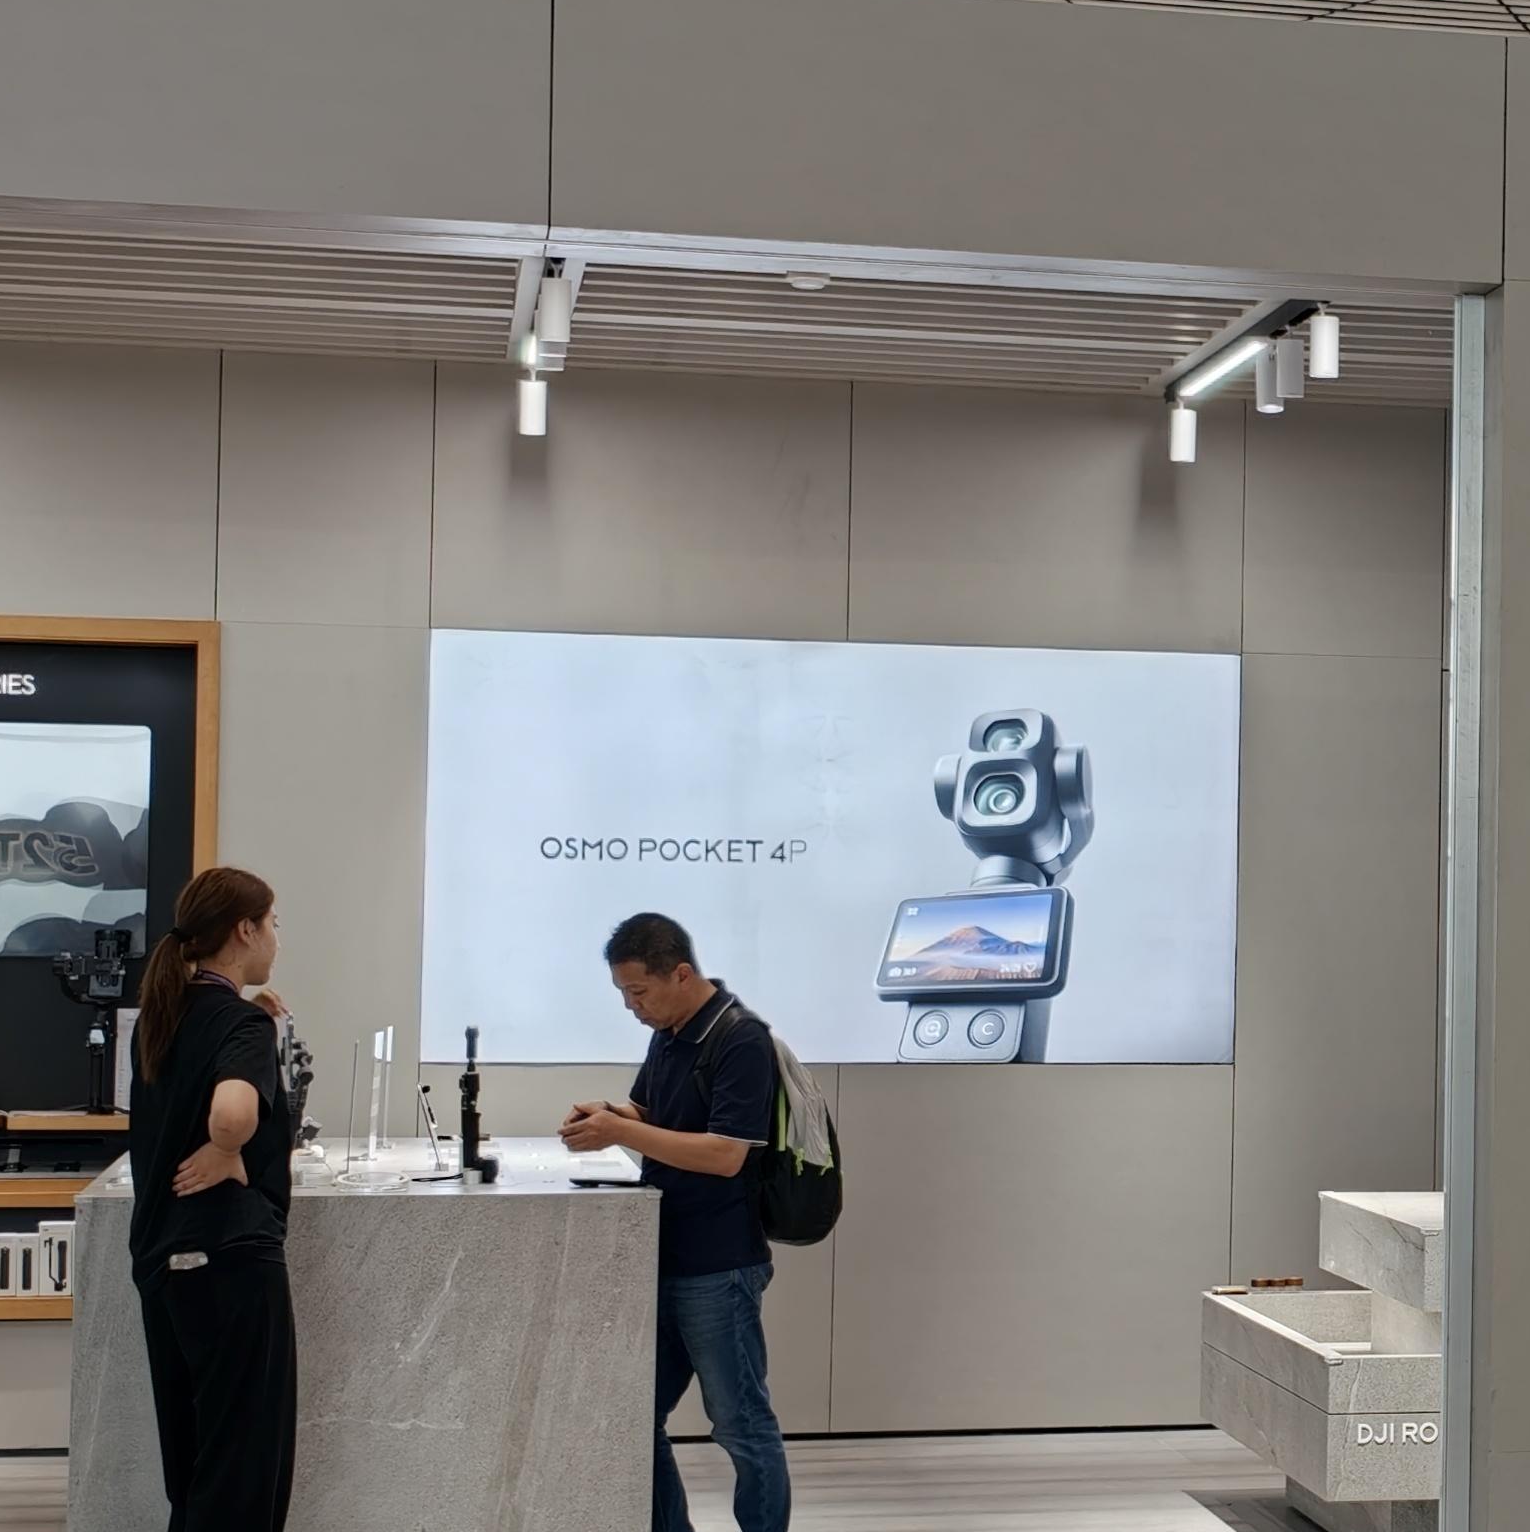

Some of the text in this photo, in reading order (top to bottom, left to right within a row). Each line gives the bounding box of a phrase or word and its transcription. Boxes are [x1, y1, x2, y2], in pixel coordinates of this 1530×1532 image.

[540, 837, 807, 863] OSMO POCKET 4P
[1357, 1423, 1394, 1445] DJI
